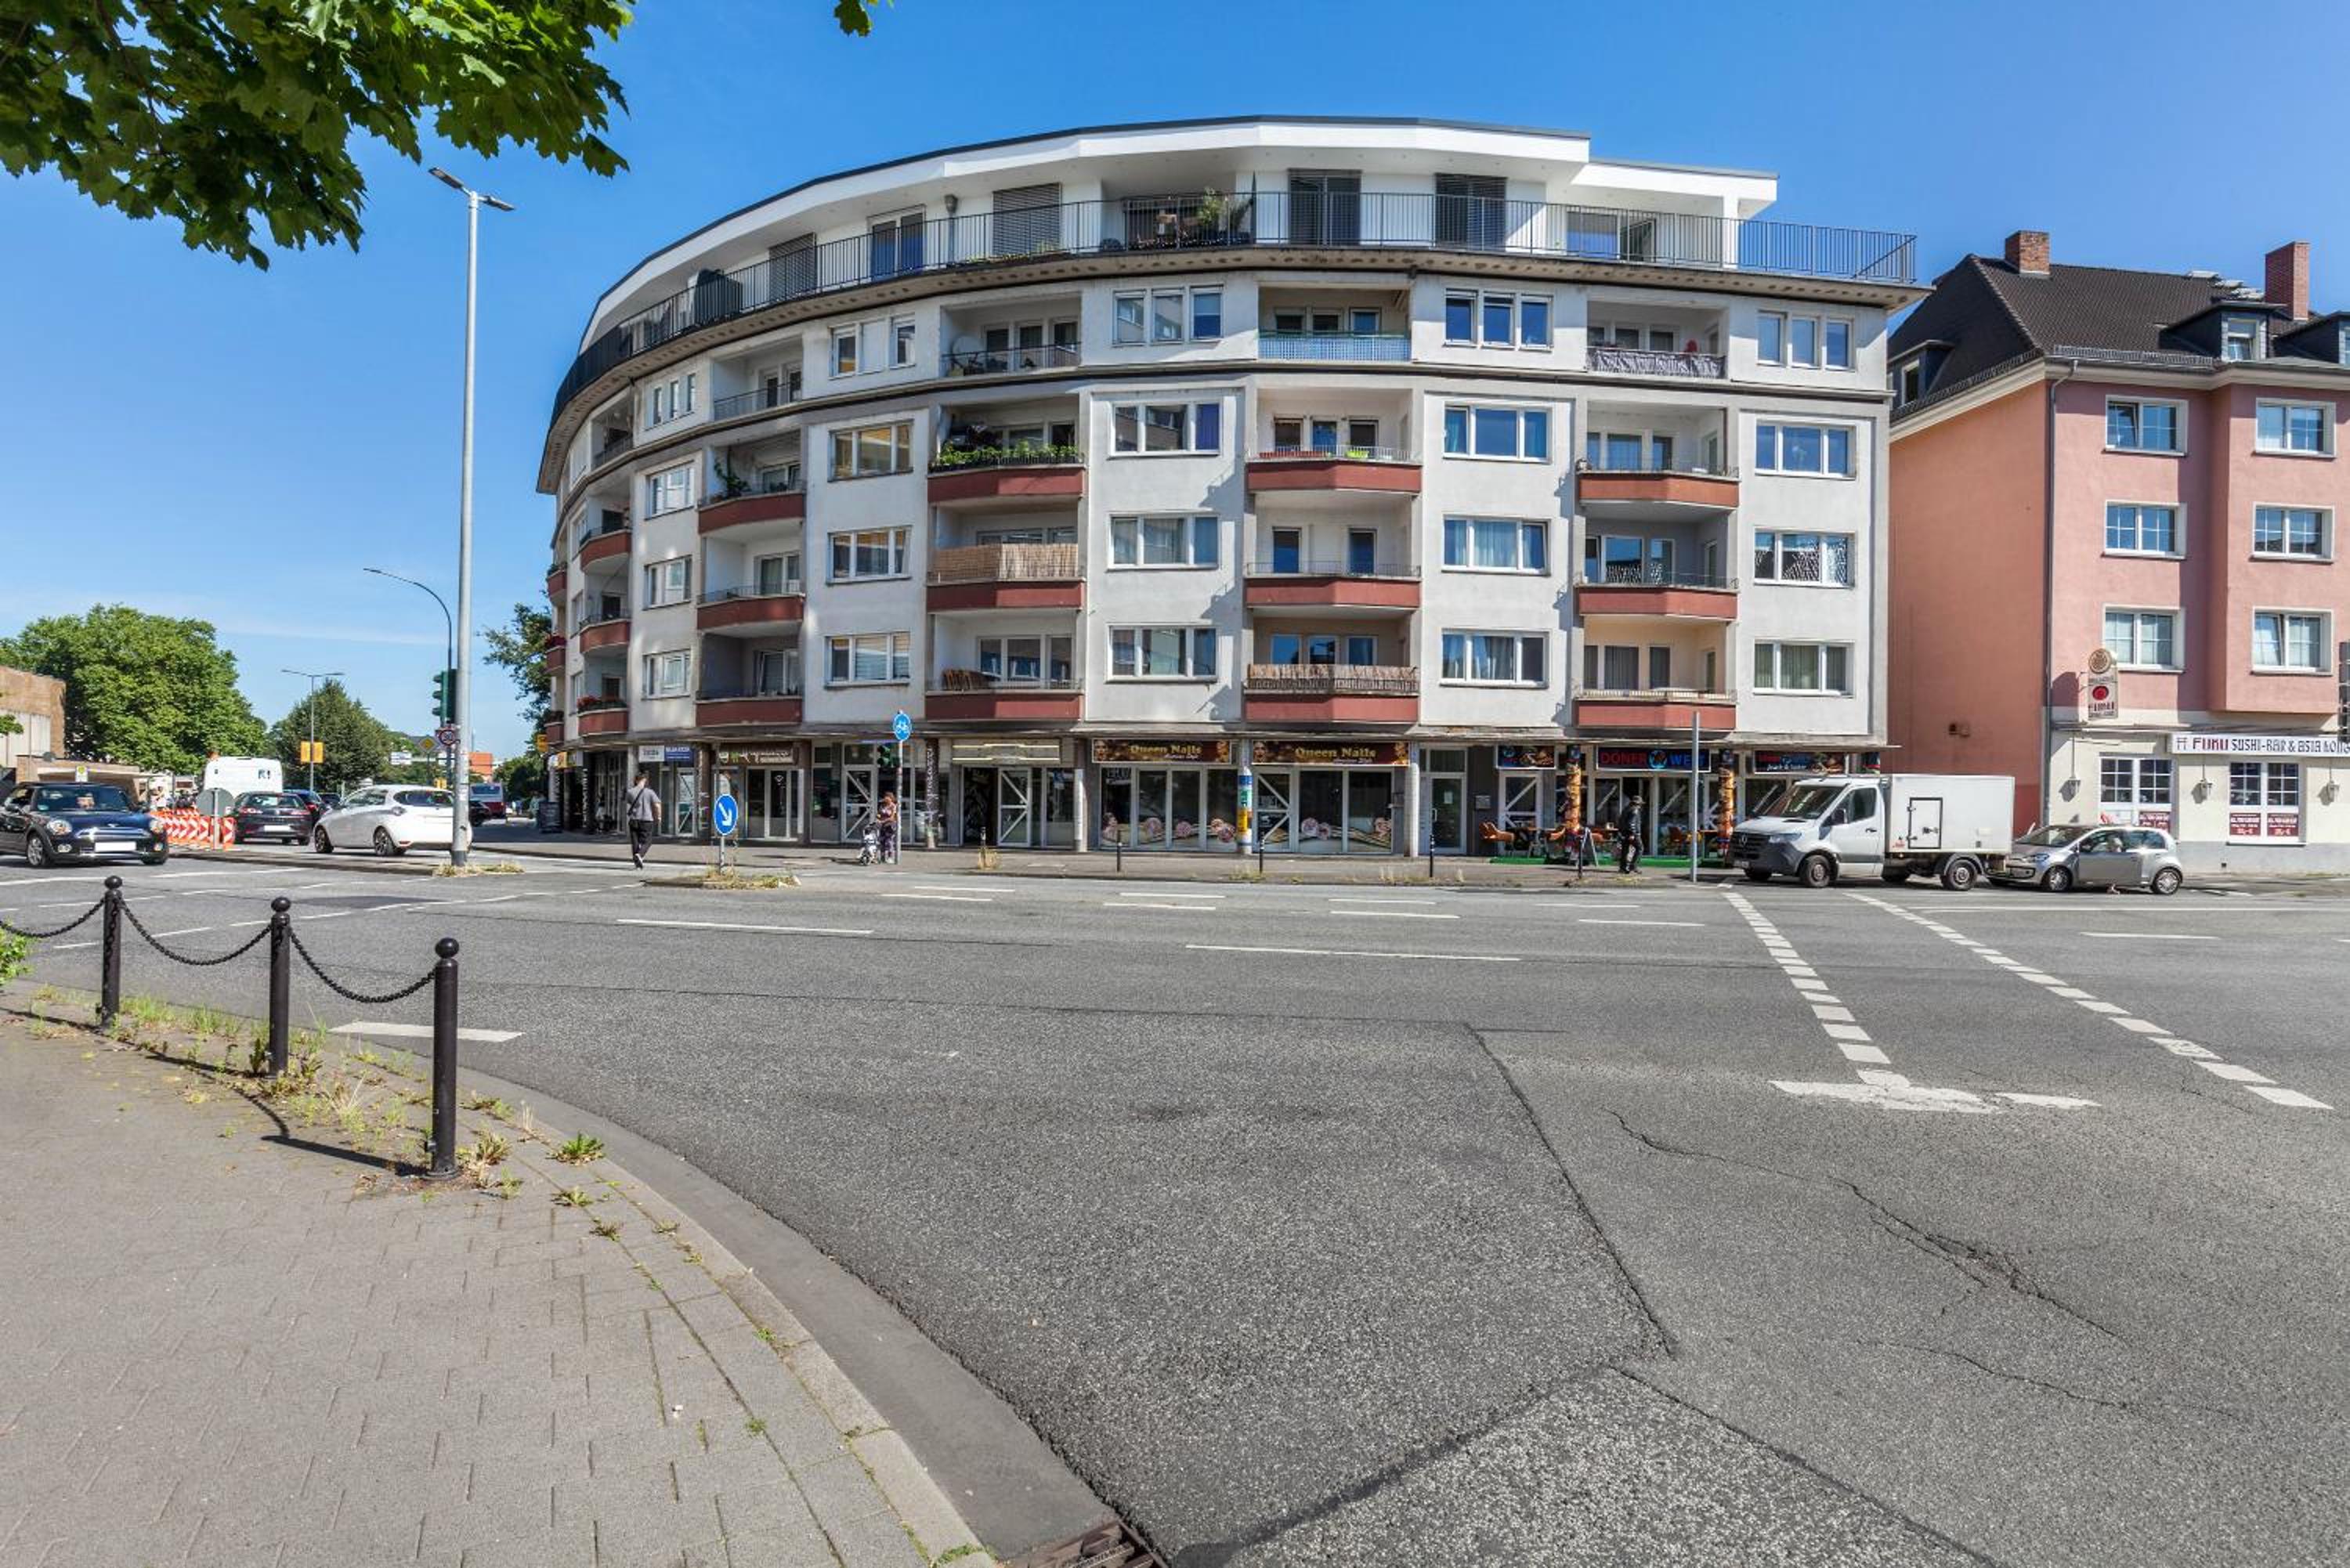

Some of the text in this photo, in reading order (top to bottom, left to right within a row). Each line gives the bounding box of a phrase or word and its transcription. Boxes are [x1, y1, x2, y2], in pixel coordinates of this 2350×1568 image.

[1130, 744, 1202, 755] Queen Nails
[2193, 737, 2229, 751] FUKU
[2232, 739, 2287, 753] SUSHI-BAR
[1294, 746, 1377, 758] Queen Nails
[1670, 753, 1706, 765] WET
